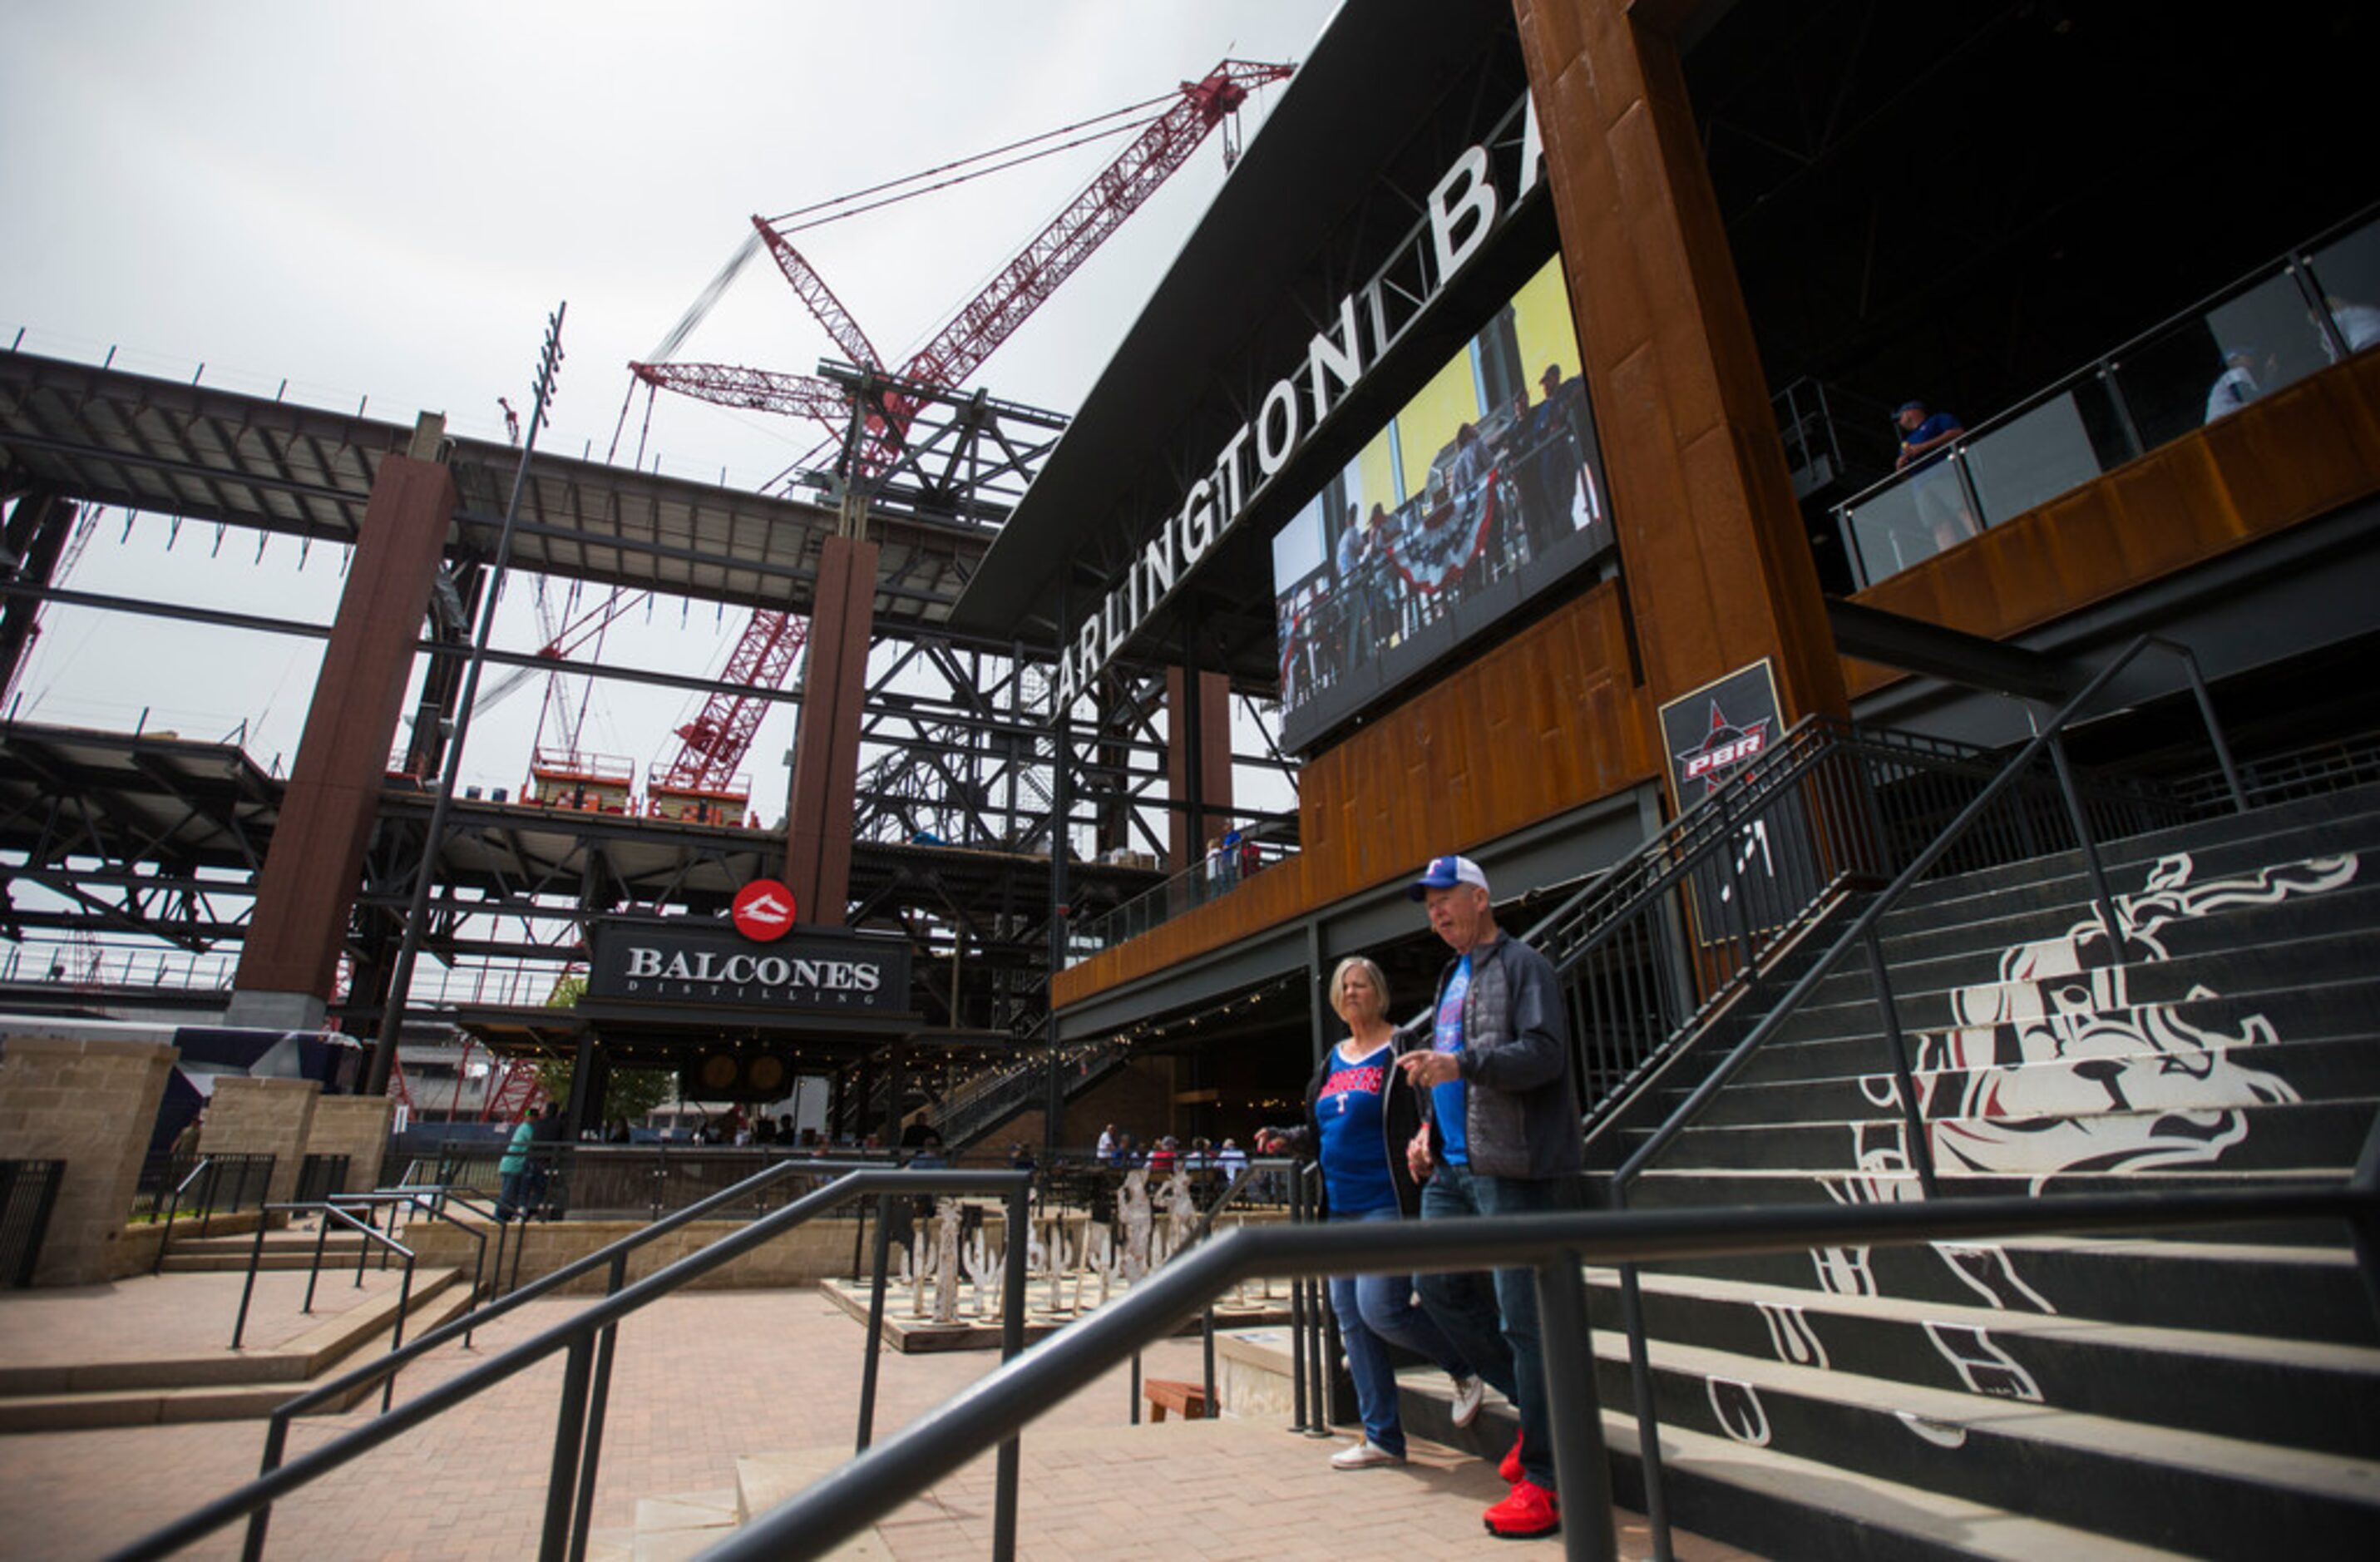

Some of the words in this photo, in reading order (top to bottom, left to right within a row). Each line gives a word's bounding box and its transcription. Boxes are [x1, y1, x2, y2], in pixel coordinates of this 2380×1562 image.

[1056, 294, 1363, 713] ARLINGTON
[1688, 734, 1760, 777] PBR
[626, 947, 880, 991] BALCONES
[628, 980, 873, 1005] DISTILLING
[1336, 1093, 1349, 1114] T
